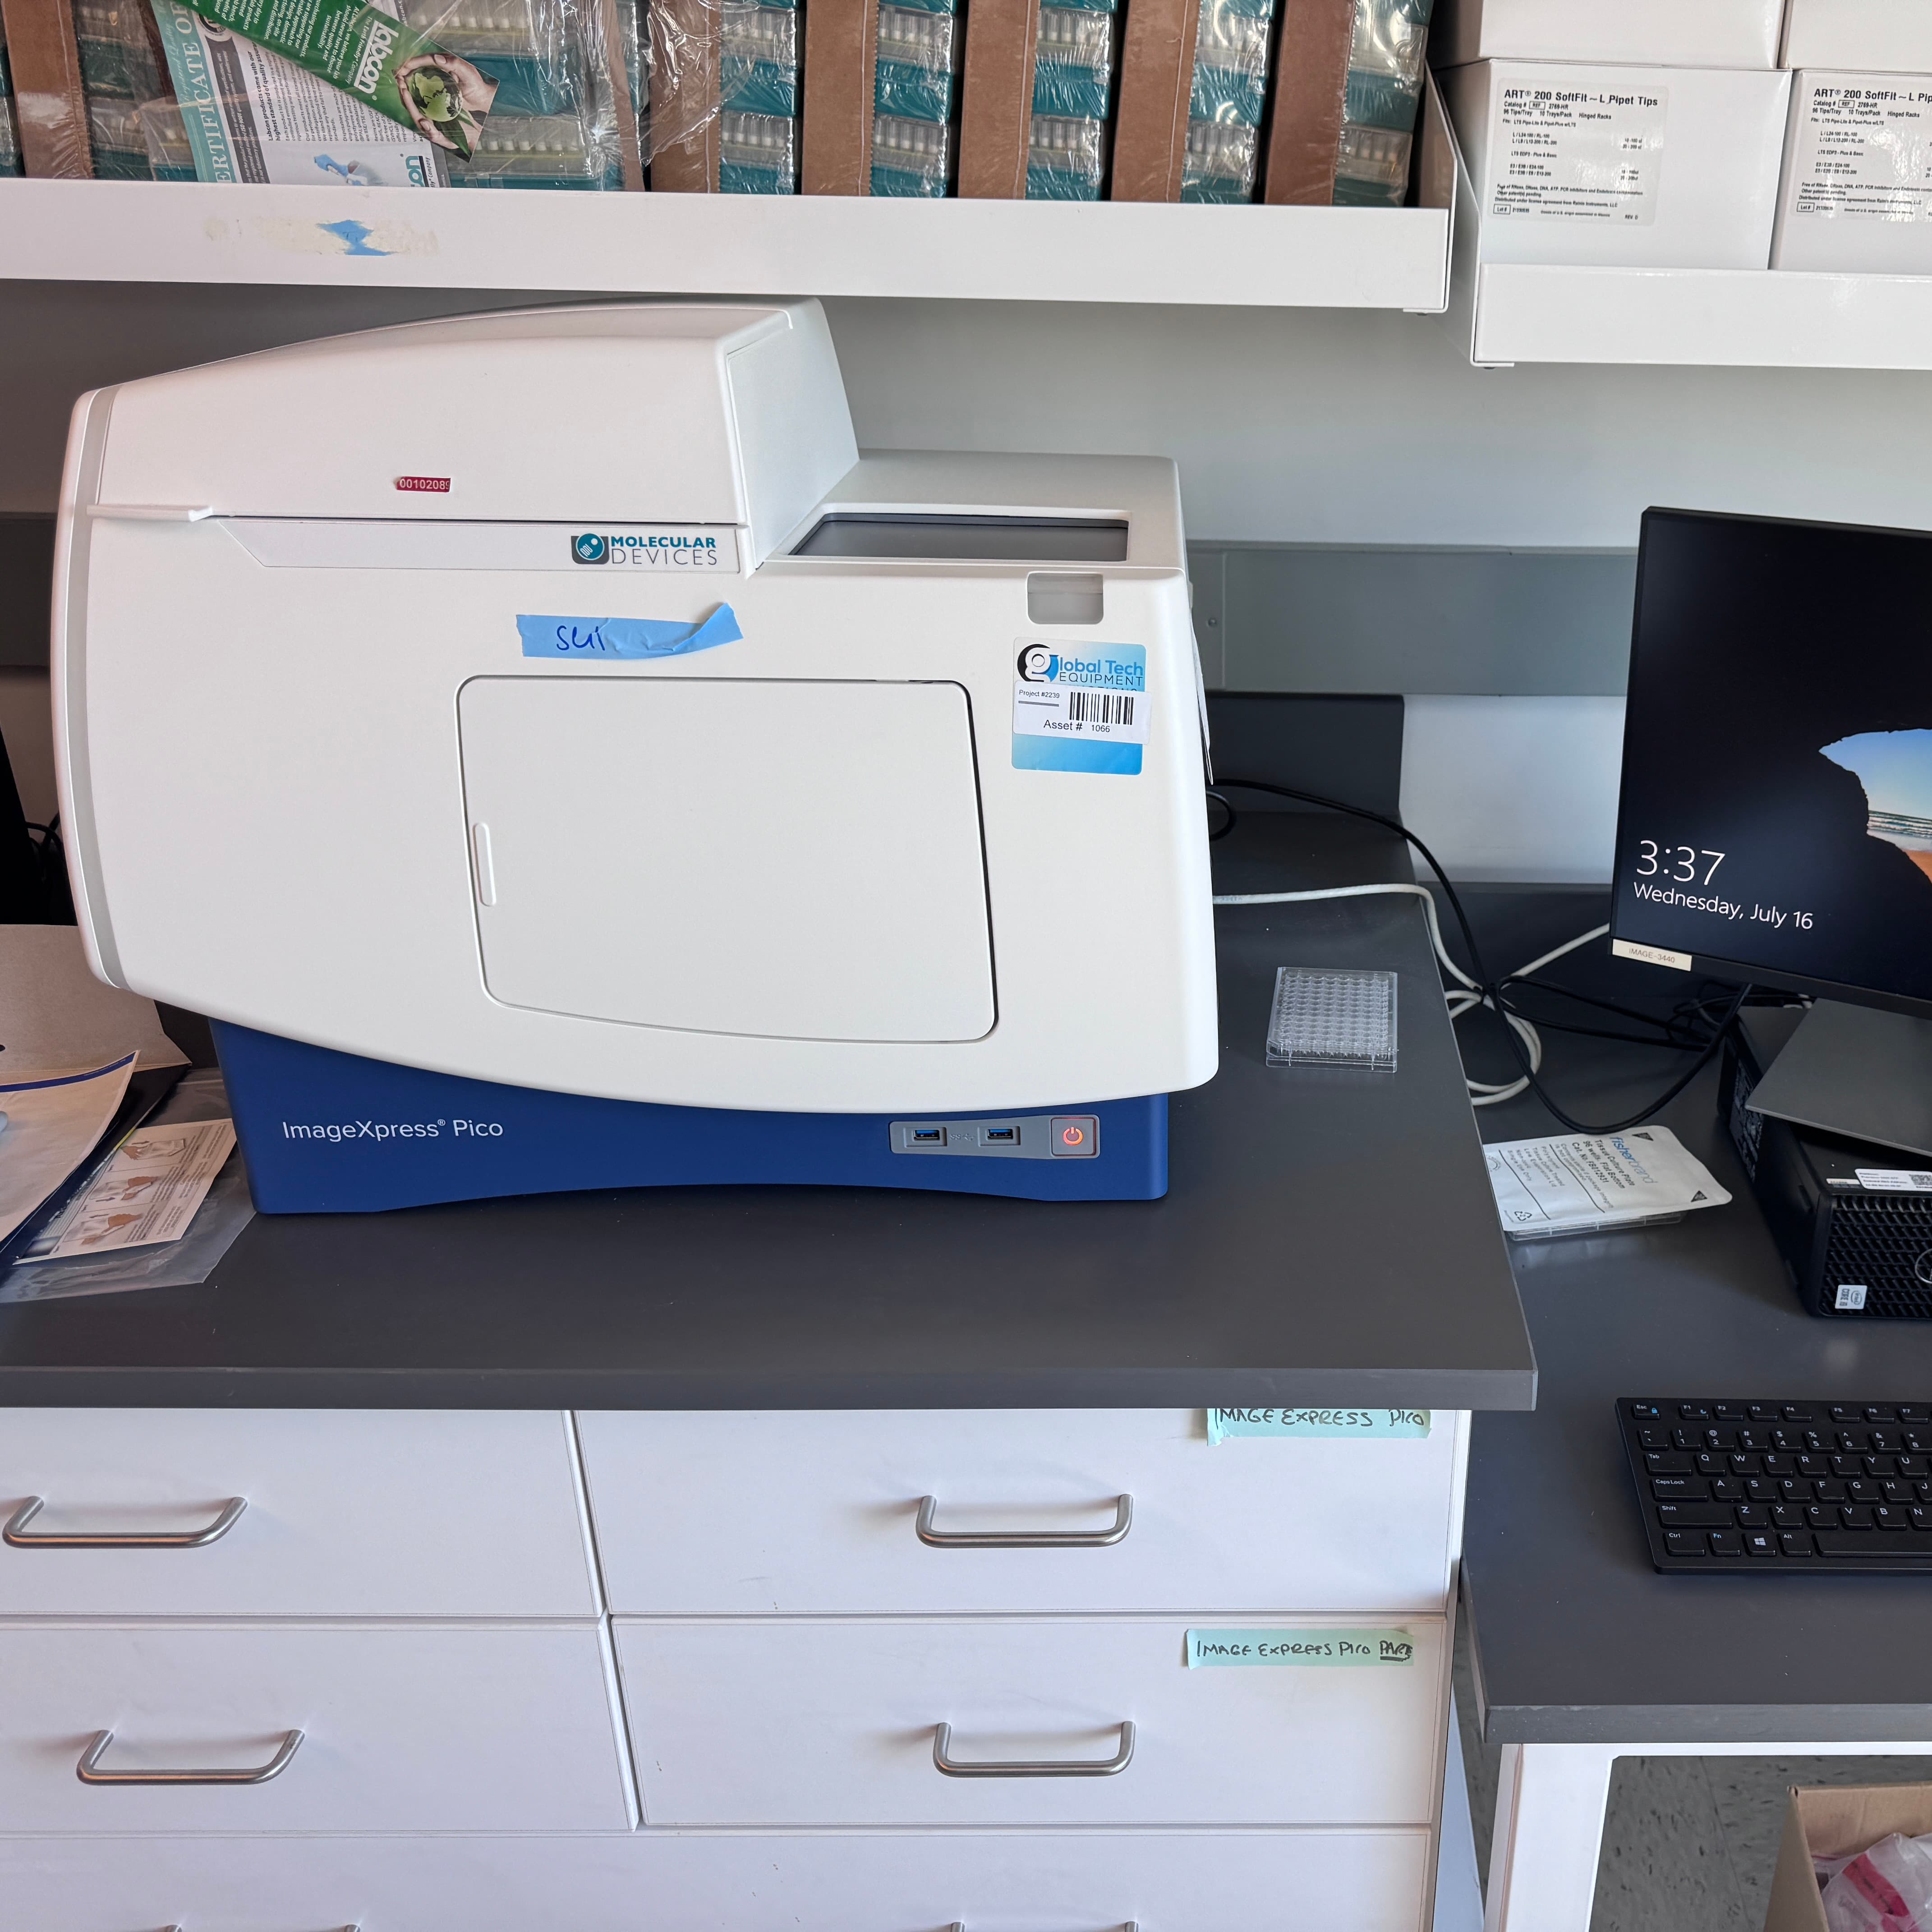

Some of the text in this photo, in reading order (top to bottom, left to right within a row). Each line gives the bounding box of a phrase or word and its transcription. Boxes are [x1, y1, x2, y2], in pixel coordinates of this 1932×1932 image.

[243, 6, 253, 30] products
[264, 10, 276, 39] distribution.
[280, 2, 296, 44] design, domestic
[331, 10, 342, 32] between
[342, 5, 351, 23] should
[273, 19, 282, 37] on-site
[290, 15, 299, 40] approach
[296, 11, 308, 39] supporting
[317, 15, 331, 48] sustainability.
[361, 25, 369, 39] Earth
[300, 33, 310, 57] products,
[325, 32, 334, 51] quality
[334, 37, 343, 50] have
[345, 33, 350, 41] we
[339, 41, 349, 59] believe
[359, 21, 399, 94] labcon
[259, 64, 268, 84] quality
[327, 55, 336, 73] choose
[345, 61, 358, 84] Company
[258, 93, 269, 119] products
[265, 92, 276, 118] standard
[1535, 92, 1551, 100] 200
[1556, 92, 1587, 102] SoftFit
[1600, 95, 1605, 103] L
[1609, 95, 1633, 105] Pipet
[1638, 97, 1657, 106] Tips
[1844, 90, 1861, 98] 200
[1865, 91, 1896, 100] SoftFit
[1909, 92, 1914, 101] L
[265, 120, 273, 141] Labcon
[271, 120, 281, 141] highest
[611, 536, 716, 548] MOLECULAR
[612, 548, 717, 565] DEVICES
[1105, 660, 1143, 676] Tech
[1059, 672, 1143, 686] EQUIPMENT
[1043, 719, 1073, 731] Asset
[1091, 724, 1110, 732] 1066
[1636, 839, 1725, 886] 3:37
[1633, 881, 1813, 930] Wednesday, July 16
[452, 1119, 503, 1136] Pico
[1595, 1140, 1635, 1186] Tissue Culture Plate
[1609, 1136, 1659, 1184] fisherbrand
[1600, 1162, 1612, 1172] Flat
[1607, 1172, 1625, 1188] Bottom
[1215, 1408, 1274, 1430] IMAGE
[1197, 1640, 1251, 1657] IMAGE
[1339, 1641, 1371, 1656] PICO
